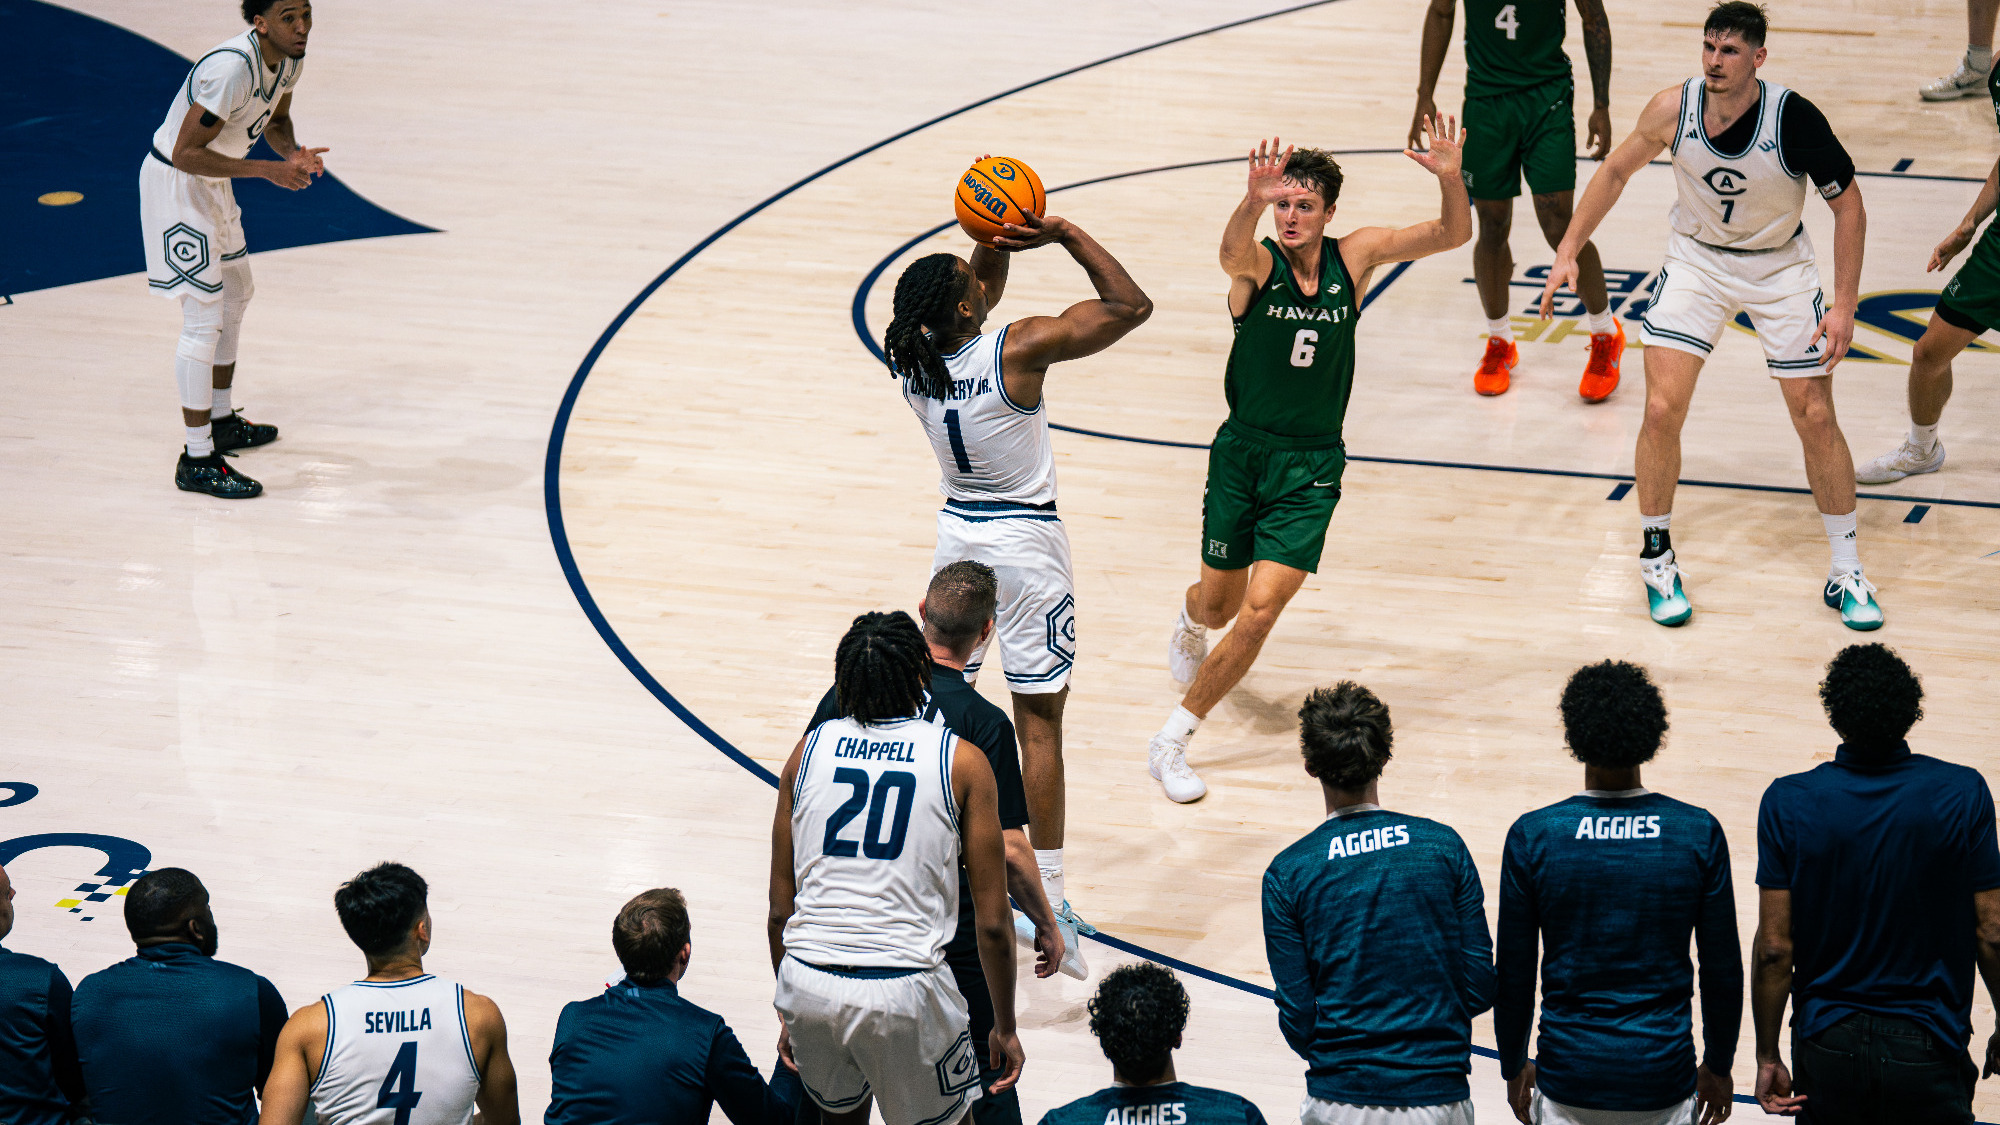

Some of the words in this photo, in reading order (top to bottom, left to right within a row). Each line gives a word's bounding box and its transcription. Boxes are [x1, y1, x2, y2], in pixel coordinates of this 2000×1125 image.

[1495, 4, 1520, 40] 4
[963, 172, 1008, 219] Wilson
[1720, 199, 1735, 224] 7
[1289, 328, 1319, 368] 6
[943, 408, 974, 474] 1
[834, 736, 916, 763] CHAPPELL
[822, 766, 917, 861] 20
[1575, 815, 1661, 840] AGGIES
[1327, 824, 1410, 860] AGGIES
[364, 1007, 432, 1034] SEVILLA
[375, 1040, 423, 1125] 4
[1103, 1102, 1187, 1125] AGGIES
